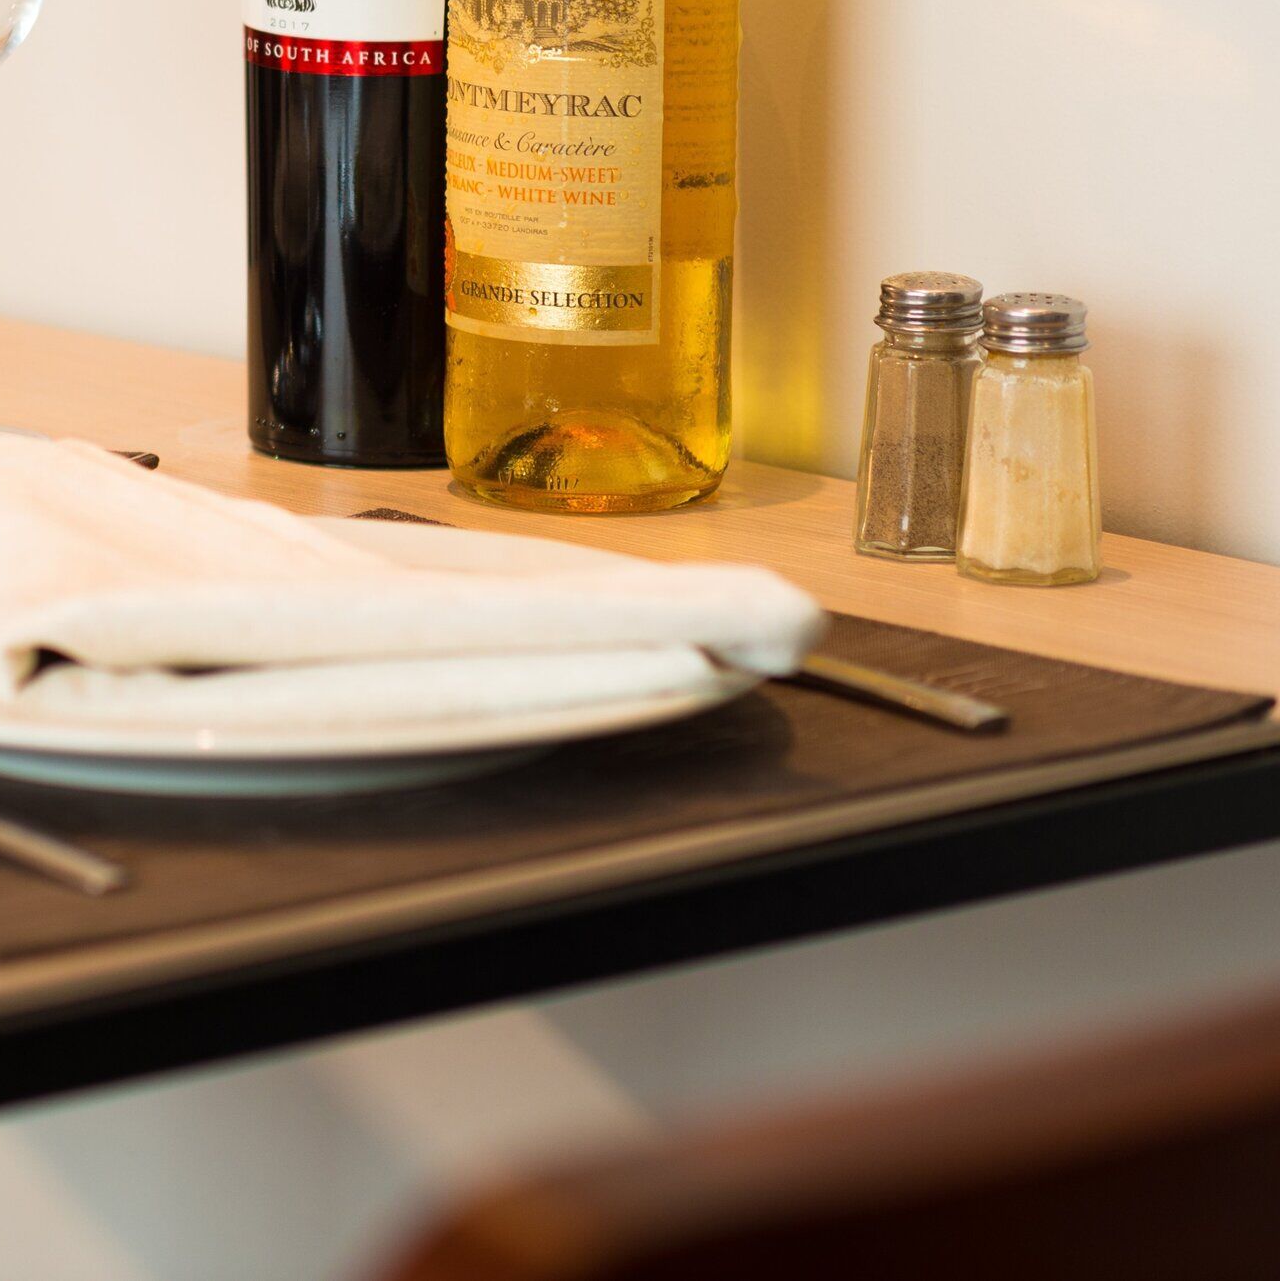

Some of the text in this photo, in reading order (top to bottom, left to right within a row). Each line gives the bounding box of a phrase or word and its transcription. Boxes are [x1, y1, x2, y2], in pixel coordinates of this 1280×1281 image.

[247, 37, 432, 65] OF SOUTH AFRICA
[447, 75, 643, 118] ONTMEYRAC
[493, 131, 512, 152] &
[516, 130, 618, 157] Caractère
[486, 158, 620, 184] MEDIUM-SWEET
[498, 184, 557, 204] WHITE
[562, 189, 617, 206] WINE
[460, 279, 644, 309] GRANDE SELECTION
